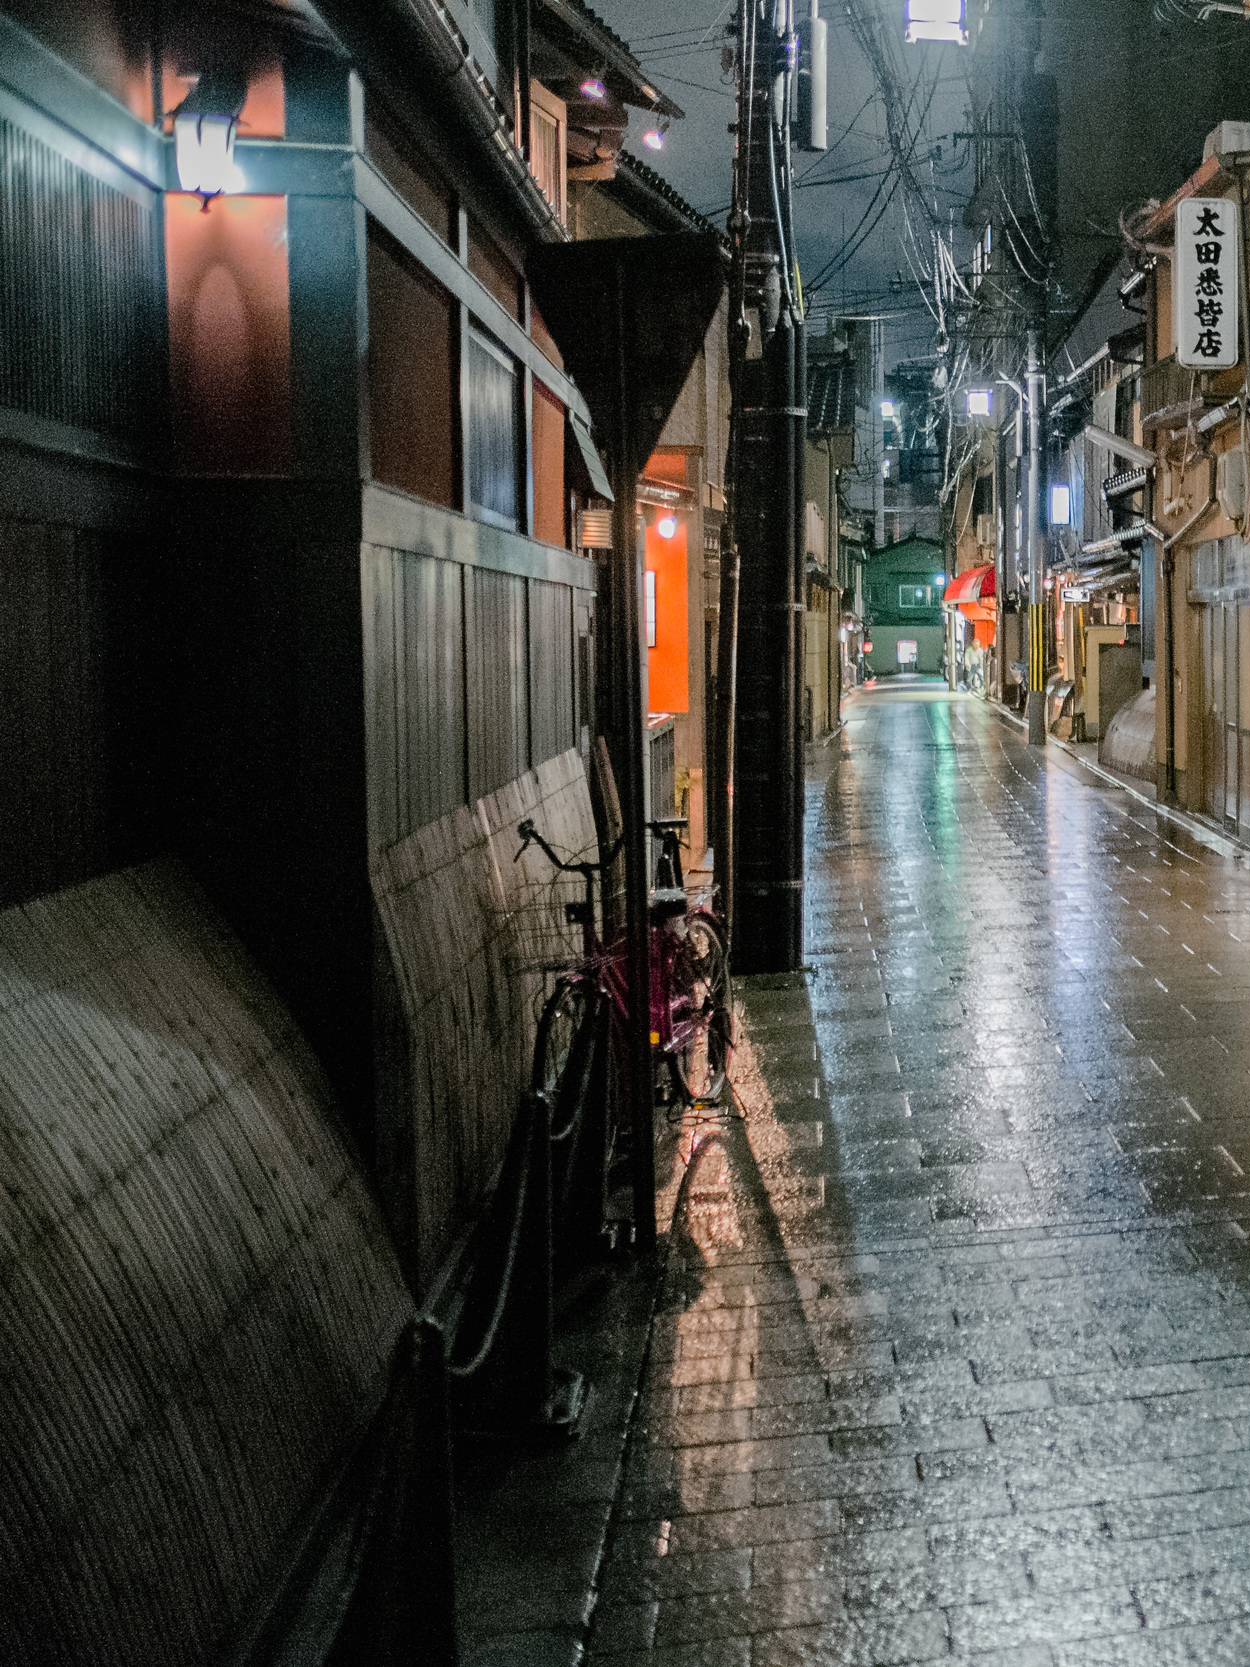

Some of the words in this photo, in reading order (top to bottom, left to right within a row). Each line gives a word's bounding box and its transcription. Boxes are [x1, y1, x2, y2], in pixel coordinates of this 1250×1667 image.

[1192, 206, 1225, 358] 太田悉皆店
